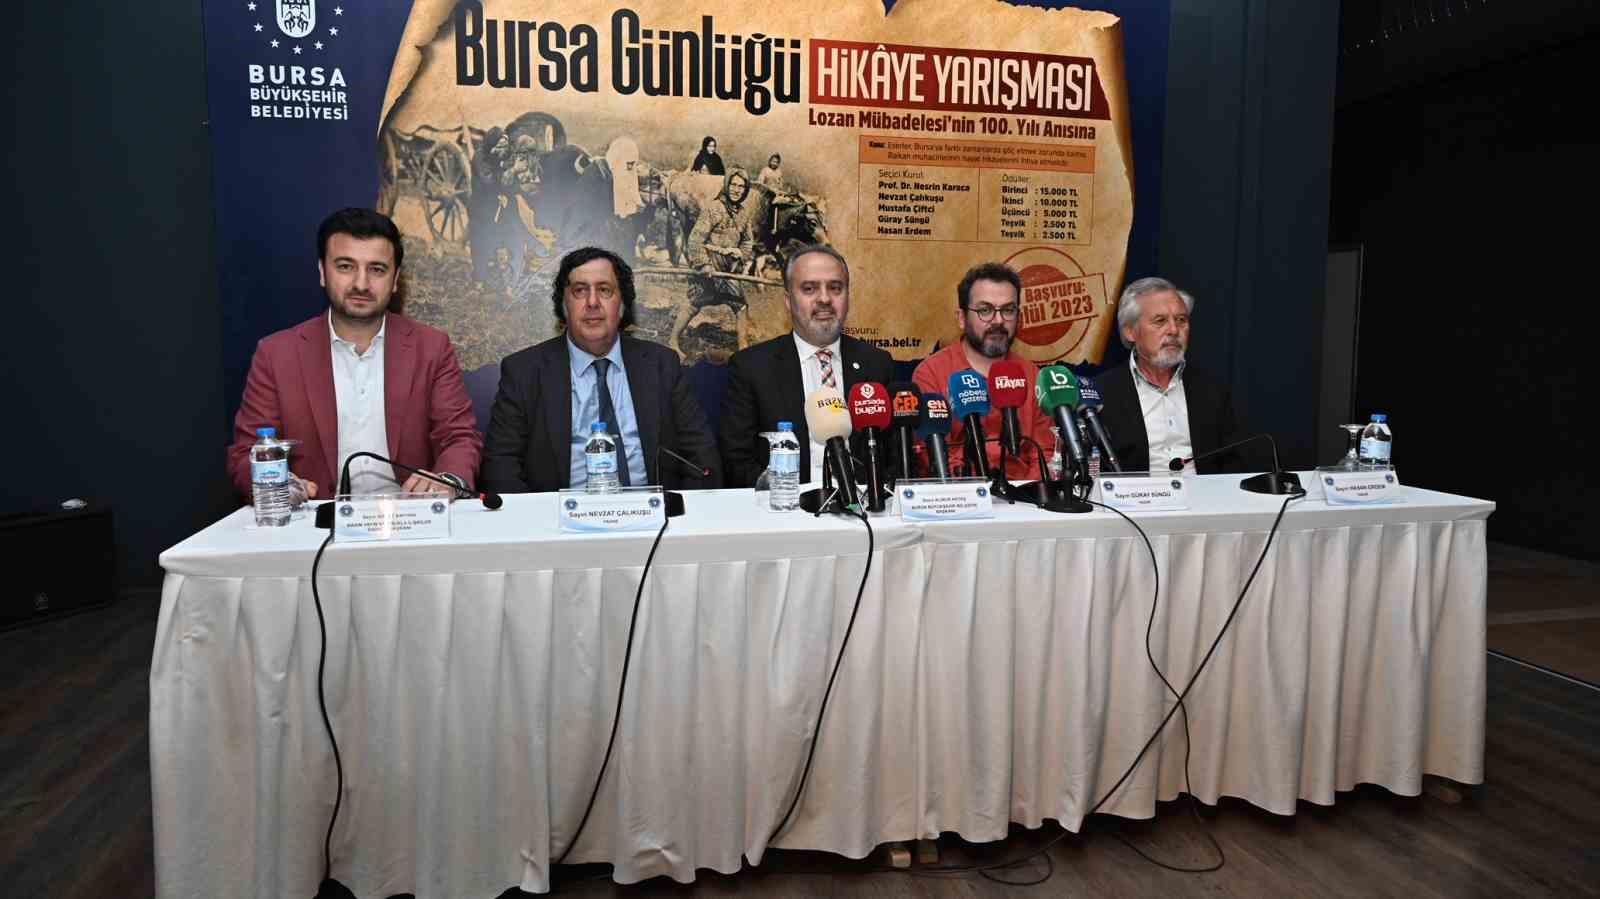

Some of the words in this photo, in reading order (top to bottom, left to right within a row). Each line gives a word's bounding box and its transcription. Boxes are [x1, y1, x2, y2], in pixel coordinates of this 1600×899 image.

[455, 0, 599, 93] Bursa
[611, 8, 800, 116] Günlüğü
[249, 64, 346, 87] BURSA
[932, 54, 1093, 112] YARIŞMASI
[250, 85, 347, 104] BÜYÜKŞEHİR
[251, 103, 348, 120] BELEDİYESİ
[808, 108, 854, 128] Lozan
[859, 110, 975, 133] Mübadelesi'nin
[980, 117, 1012, 135] 100.
[1016, 119, 1040, 137] Yılı
[1042, 120, 1096, 140] Anısına
[878, 181, 898, 190] Prof.
[901, 182, 912, 190] Dr.
[913, 182, 940, 191] Nesrin
[942, 183, 970, 192] Karaca
[1001, 185, 1028, 194] Birinci
[1040, 187, 1068, 196] 15.000
[1069, 188, 1079, 197] TL
[878, 192, 907, 201] Nevzat
[909, 193, 944, 203] Çalıkuşu
[1001, 195, 1024, 205] İkinci
[1040, 198, 1068, 207] 10.000
[1069, 199, 1079, 208] TL
[878, 204, 911, 213] Mustafa
[1001, 206, 1031, 216] Üçüncü
[1043, 209, 1067, 218] 5.000
[1069, 210, 1078, 219] TL
[878, 215, 903, 225] Güray
[904, 215, 930, 224] Süngü
[1001, 219, 1026, 228] Teşvik
[1043, 220, 1066, 229] 2.500
[1068, 221, 1077, 229] TL
[877, 226, 903, 235] Hasan
[905, 227, 931, 236] Erdem
[1001, 230, 1025, 239] Teşvik
[1042, 231, 1065, 240] 2.500
[1067, 231, 1076, 240] TL
[1024, 281, 1086, 303] Başvuru:
[1050, 294, 1093, 320] 2023
[841, 327, 880, 336] aşvuru:
[569, 511, 587, 519] Sayın
[589, 509, 615, 517] NEVZAT
